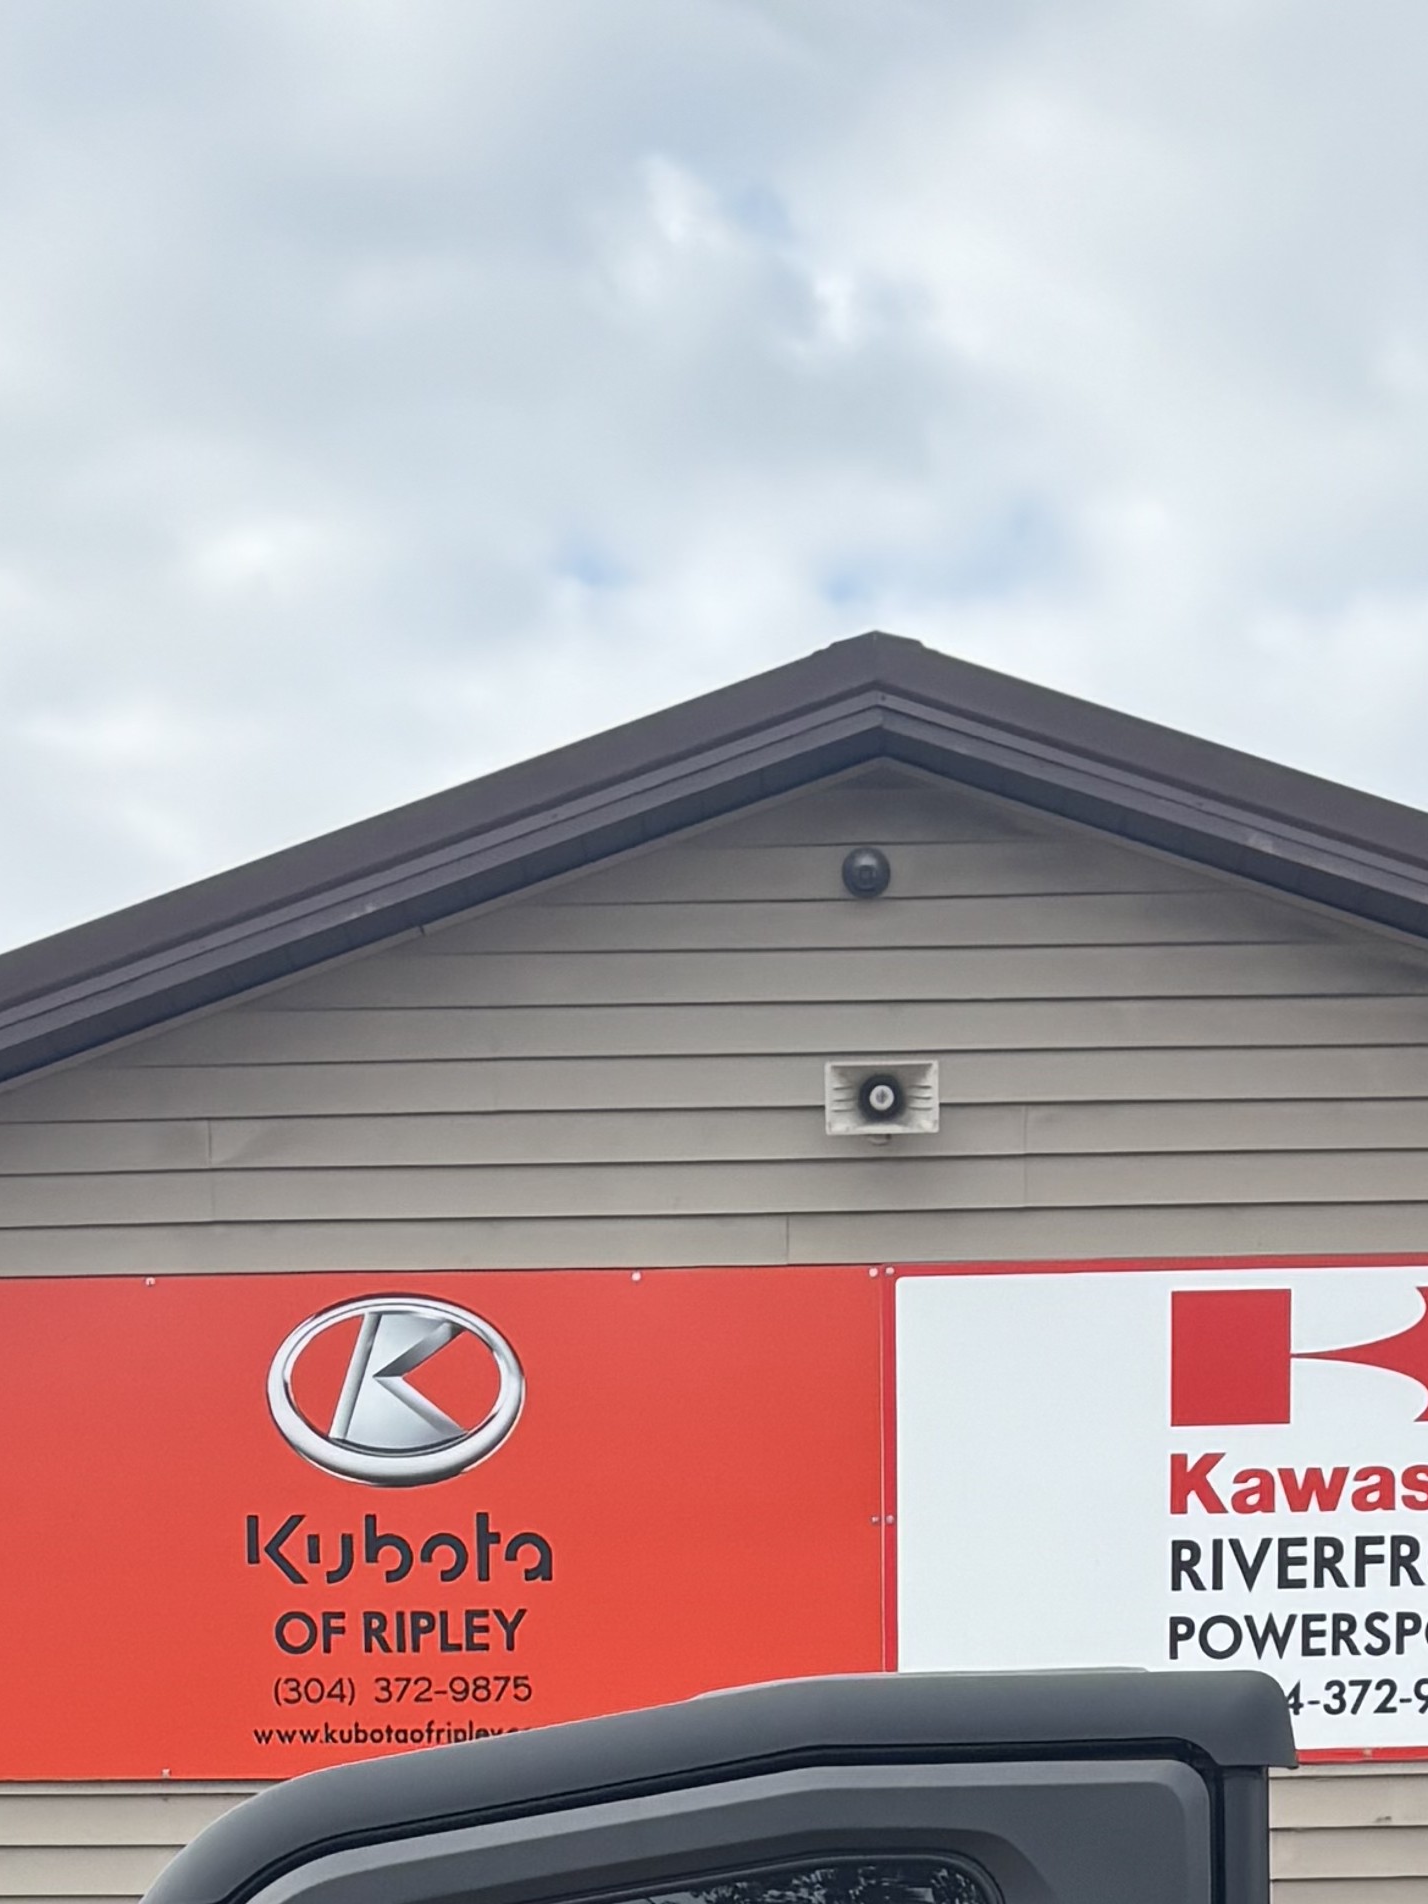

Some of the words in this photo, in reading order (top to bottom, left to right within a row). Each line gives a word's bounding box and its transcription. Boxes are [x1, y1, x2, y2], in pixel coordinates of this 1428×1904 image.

[246, 1512, 552, 1584] Kubota
[275, 1610, 346, 1654] OF
[362, 1608, 528, 1654] RIPLEY
[273, 1677, 356, 1706] (304)
[374, 1675, 533, 1703] 372-9875
